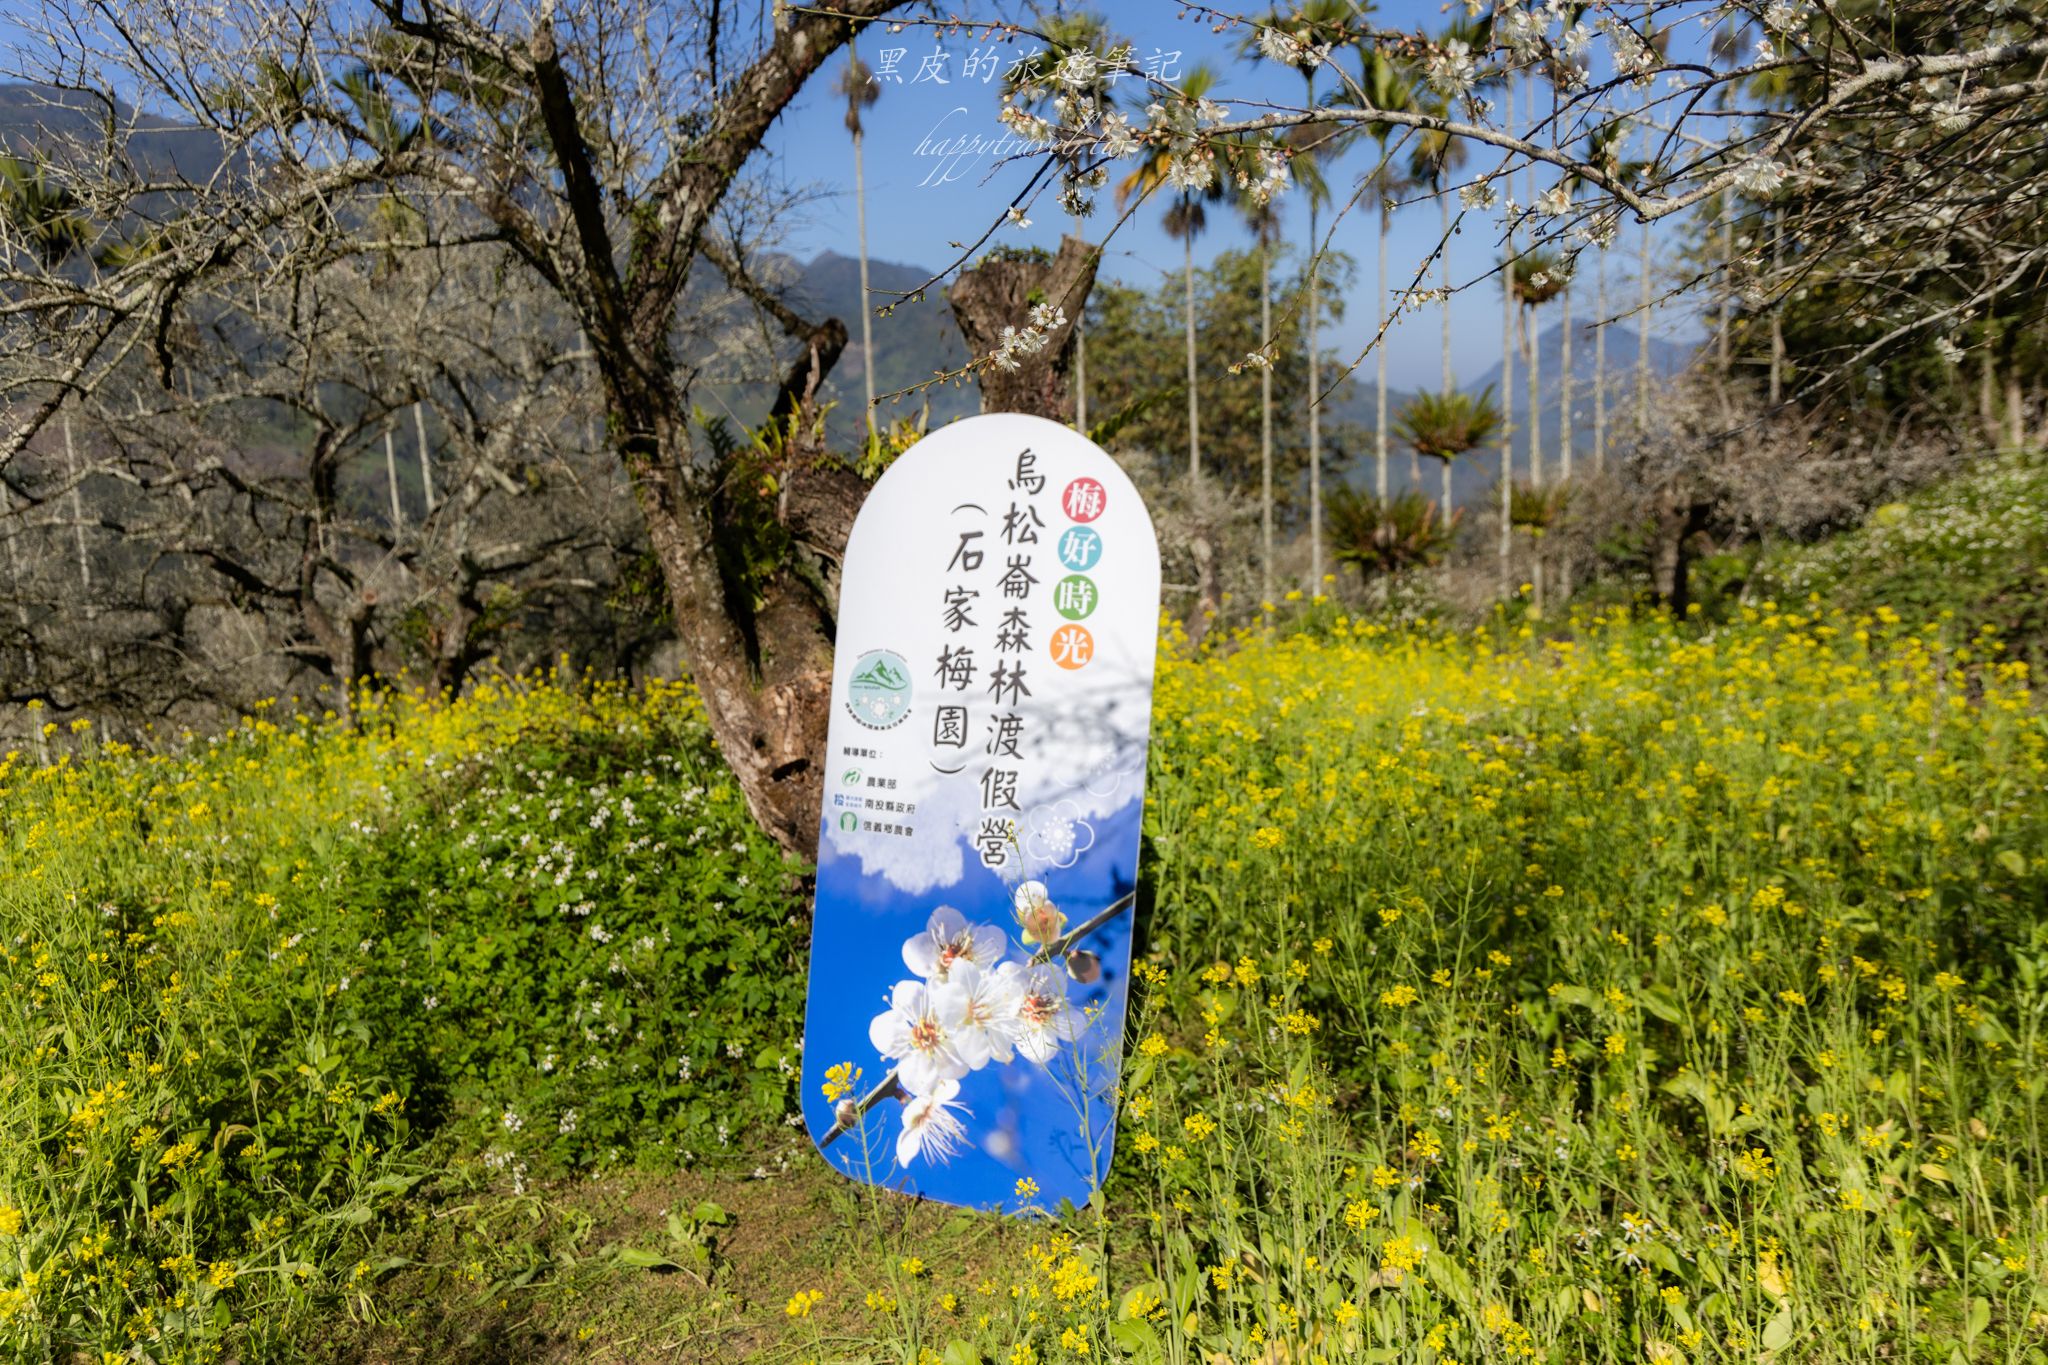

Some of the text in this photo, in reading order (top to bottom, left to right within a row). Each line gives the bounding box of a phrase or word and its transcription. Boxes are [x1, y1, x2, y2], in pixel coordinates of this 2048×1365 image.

[1054, 480, 1103, 665] 梅好時光
[976, 448, 1046, 866] 烏松崙森林渡假營
[865, 798, 915, 815] 南投縣政府
[866, 776, 897, 790] 農業部
